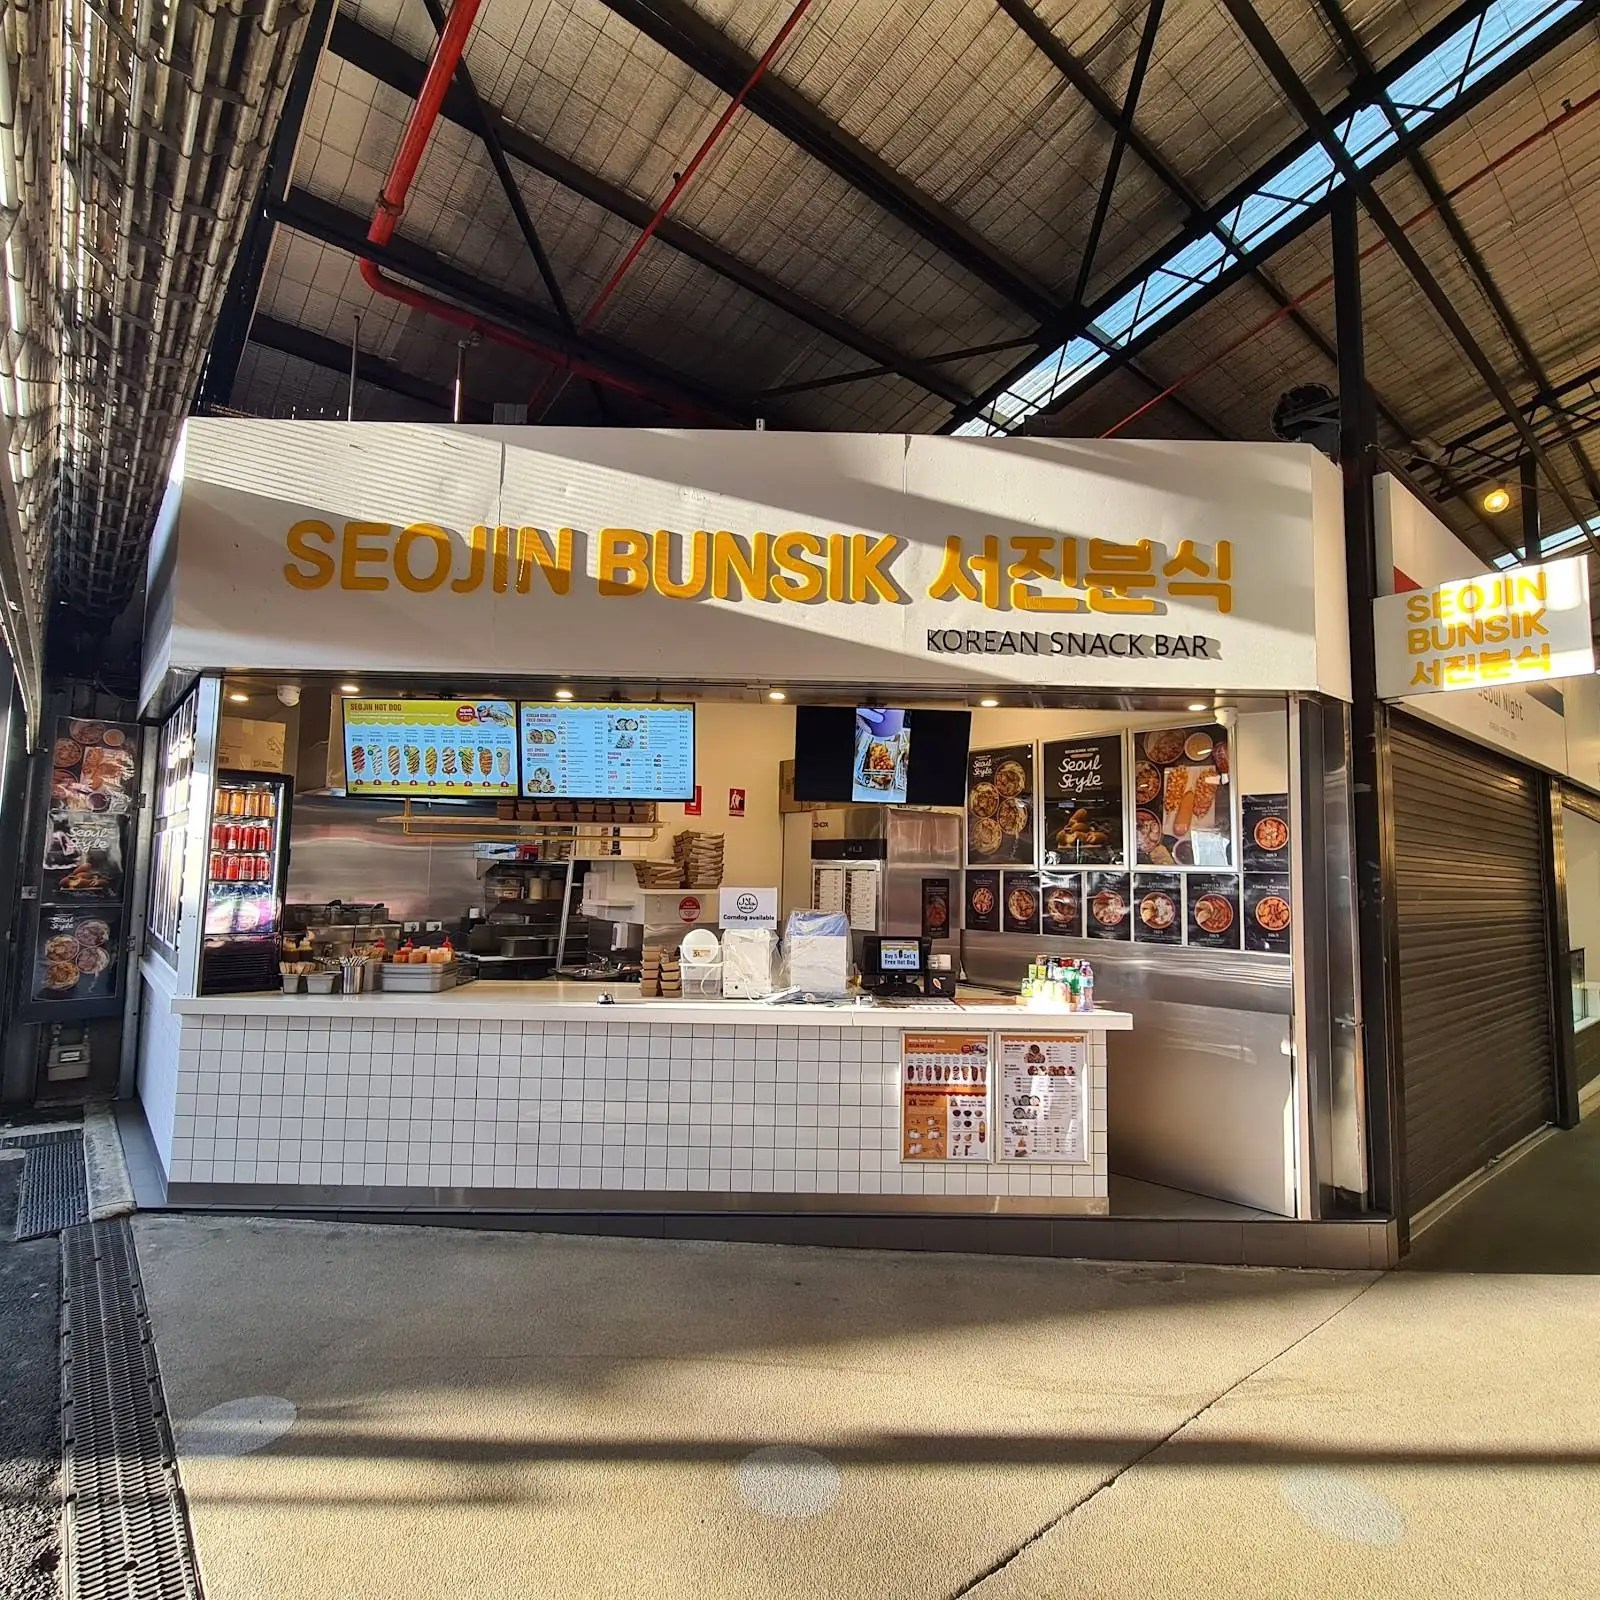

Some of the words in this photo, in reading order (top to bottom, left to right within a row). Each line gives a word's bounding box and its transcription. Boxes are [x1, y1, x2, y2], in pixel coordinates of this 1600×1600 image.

[283, 519, 573, 596] SEOJIN
[598, 527, 902, 604] BUNSIK
[928, 534, 1233, 615] 서진분식
[1406, 571, 1547, 624] SEOJIN
[927, 629, 1039, 654] KOREAN
[1049, 631, 1145, 656] SNACK
[1155, 635, 1209, 658] BAR
[1407, 608, 1550, 656] BUNSIK
[1409, 642, 1552, 687] 서진분식
[350, 703, 373, 711] SEOJIN
[374, 703, 387, 711] HOT
[1503, 691, 1524, 721] Night
[1057, 754, 1103, 773] Seoul
[1057, 771, 1104, 793] Style
[66, 826, 109, 838] Seoul
